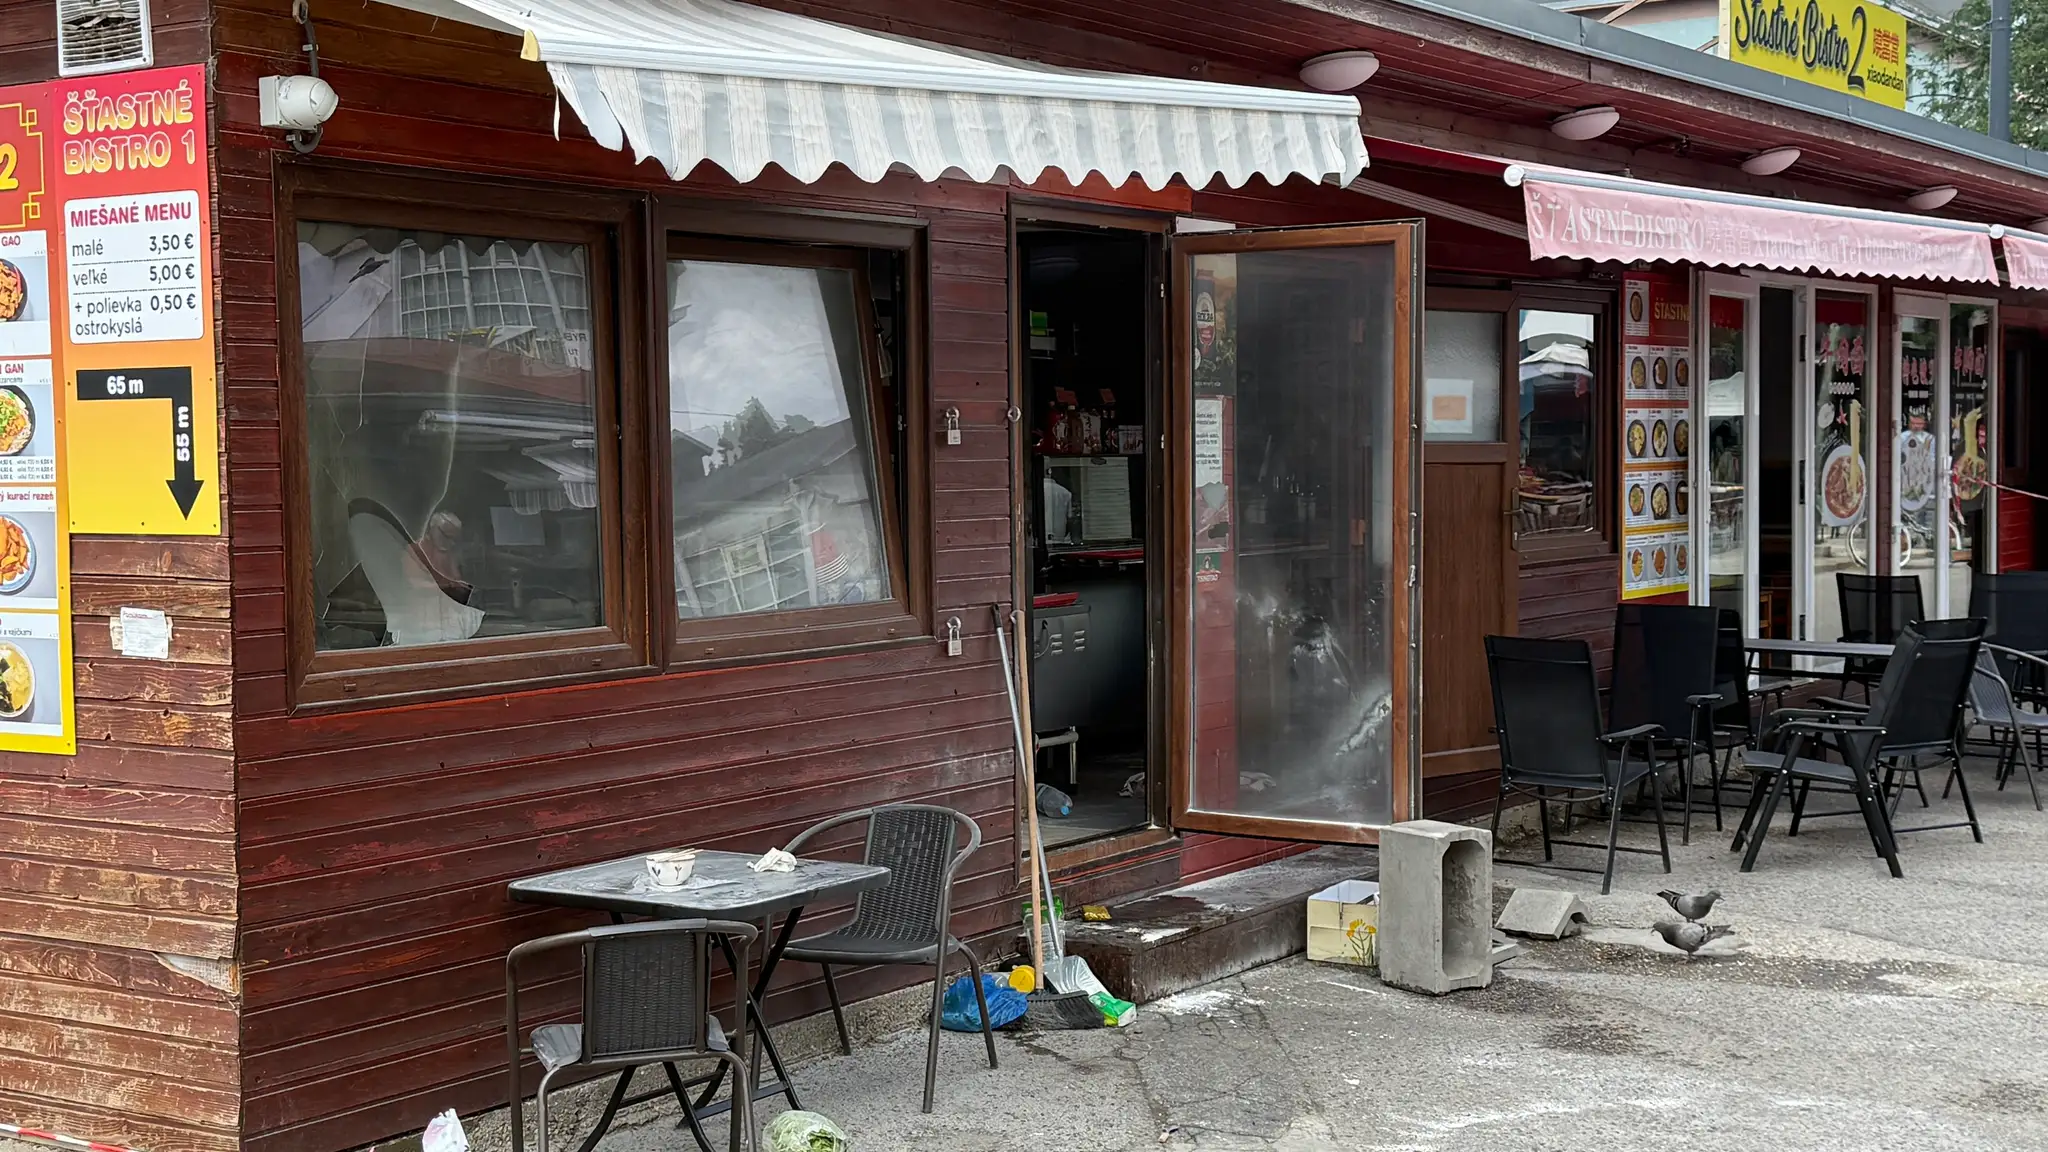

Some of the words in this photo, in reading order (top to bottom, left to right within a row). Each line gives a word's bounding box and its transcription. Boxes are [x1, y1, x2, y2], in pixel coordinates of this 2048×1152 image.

[1802, 0, 1848, 71] Bistro
[1848, 6, 1866, 93] 2
[1867, 64, 1904, 91] xiaodandan
[64, 79, 194, 135] ŠŤASTNÉ
[64, 131, 171, 175] BISTRO
[181, 130, 195, 165] 1
[0, 142, 19, 191] 2
[70, 202, 139, 228] MIEŠANÉ
[145, 201, 192, 222] MENU
[72, 238, 103, 257] malé
[149, 235, 180, 253] 3,50
[184, 233, 194, 249] €
[73, 268, 108, 286] veľké
[149, 266, 181, 282] 5,00
[185, 264, 195, 280] €
[75, 302, 83, 312] +
[87, 296, 142, 317] polievka
[150, 294, 183, 312] 0,50
[186, 294, 196, 309] €
[1654, 297, 1690, 321] ŠŤASTN
[75, 316, 143, 337] ostrokyslá
[5, 363, 24, 374] GAN
[107, 376, 126, 394] 65
[129, 378, 144, 393] m
[177, 406, 189, 428] m
[176, 433, 191, 461] 55
